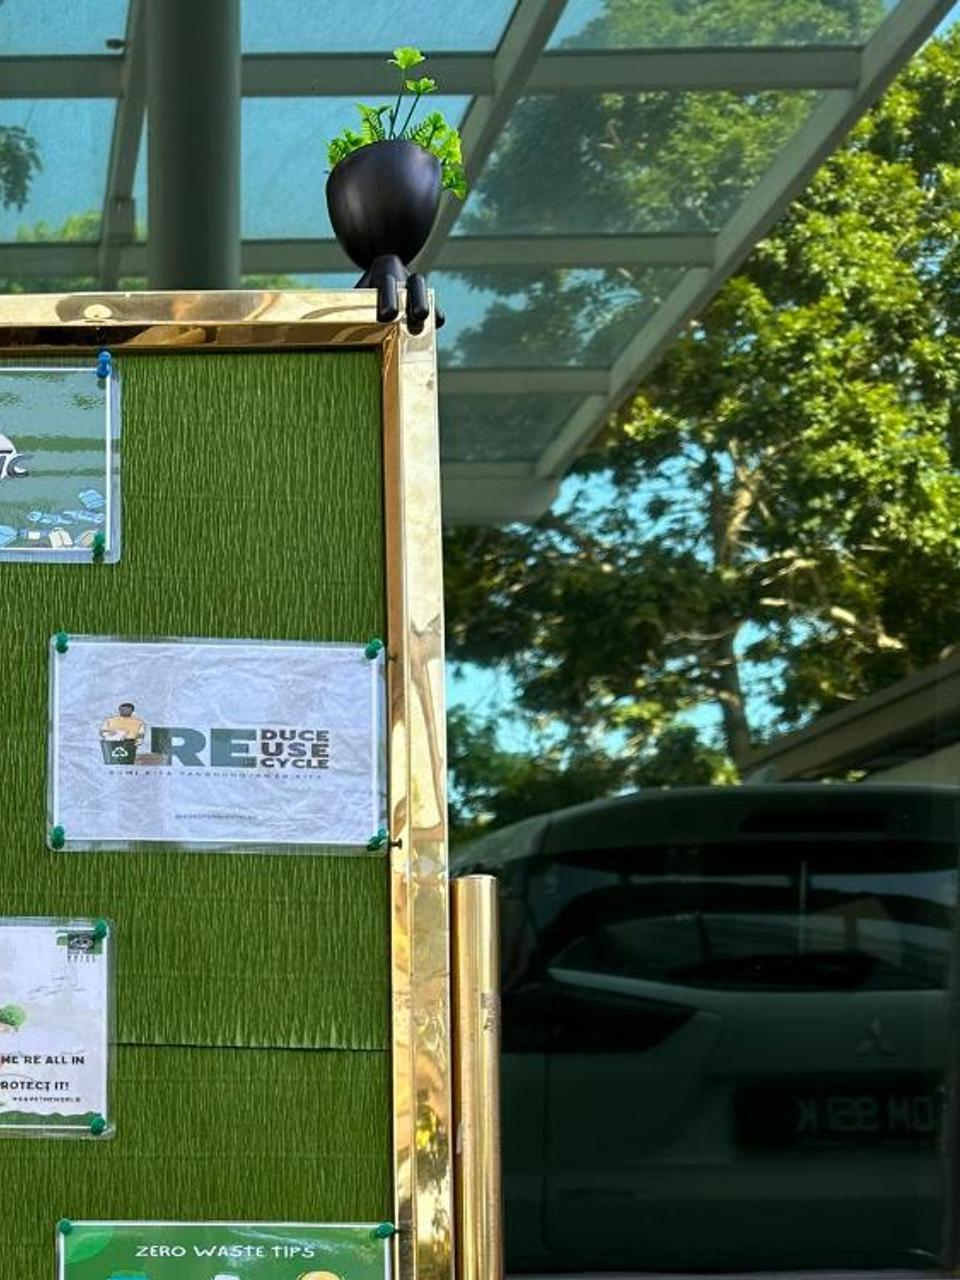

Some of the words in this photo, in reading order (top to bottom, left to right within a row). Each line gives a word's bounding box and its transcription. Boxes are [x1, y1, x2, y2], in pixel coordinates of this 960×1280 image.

[260, 729, 330, 742] DUCE
[150, 726, 259, 768] RE
[260, 742, 330, 759] USE
[260, 757, 330, 769] CYCLE
[45, 1055, 68, 1065] ALL
[71, 1055, 85, 1065] IN
[54, 1081, 70, 1091] IT!
[135, 1244, 187, 1258] ZERO
[193, 1244, 265, 1258] WASTE
[271, 1245, 316, 1259] TIPS
